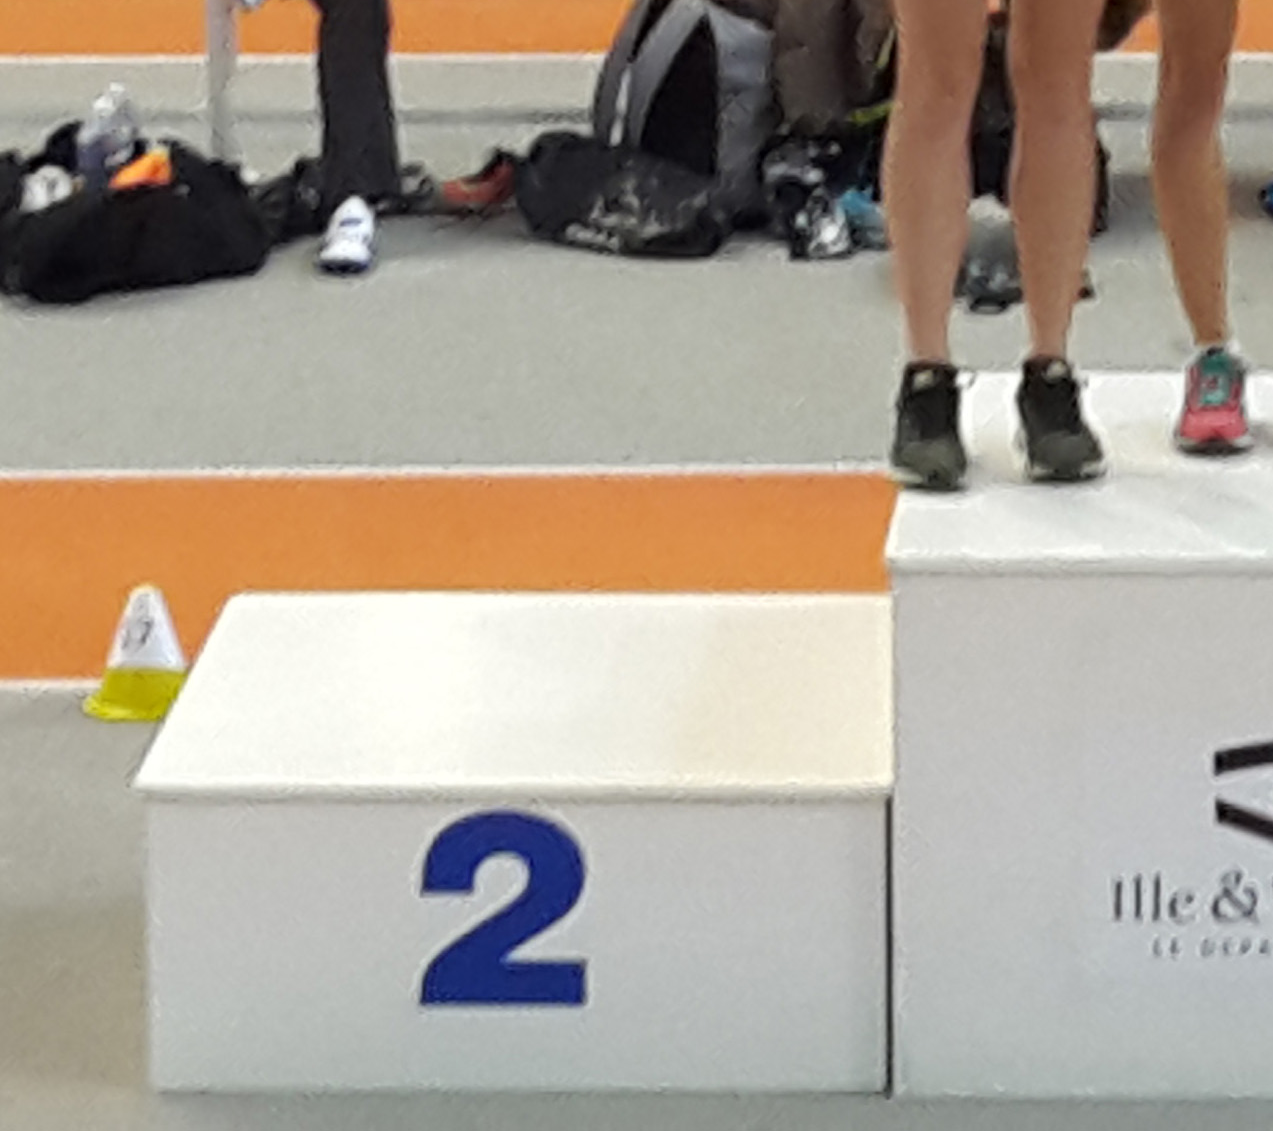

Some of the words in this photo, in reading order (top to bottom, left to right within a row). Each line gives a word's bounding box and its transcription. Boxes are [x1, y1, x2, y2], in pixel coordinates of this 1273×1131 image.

[419, 810, 587, 1007] 2
[1112, 871, 1200, 924] Ille
[1210, 869, 1259, 924] &
